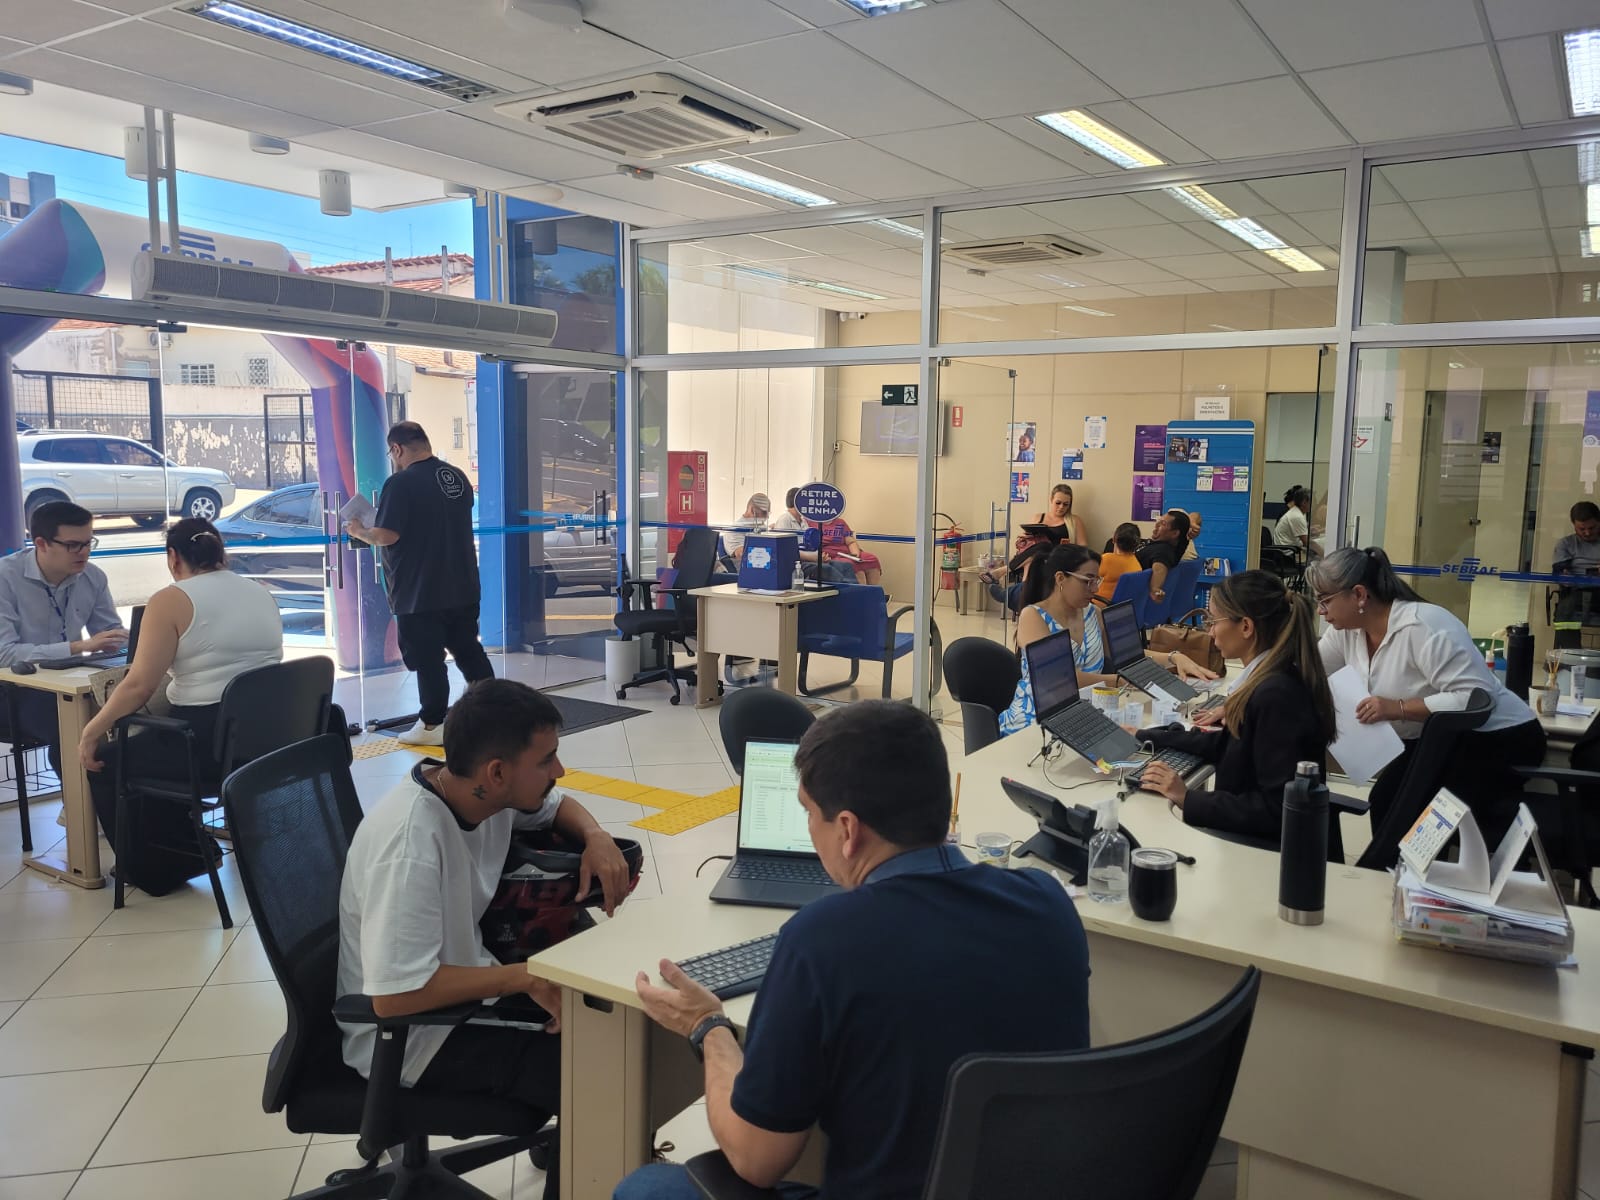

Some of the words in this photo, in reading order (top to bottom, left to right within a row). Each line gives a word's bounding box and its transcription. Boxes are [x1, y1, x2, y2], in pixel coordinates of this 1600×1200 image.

[801, 490, 838, 498] RETIRE
[682, 495, 692, 511] H
[808, 498, 830, 506] SUA
[800, 506, 838, 515] SENHA
[1442, 564, 1498, 575] SEBRAE
